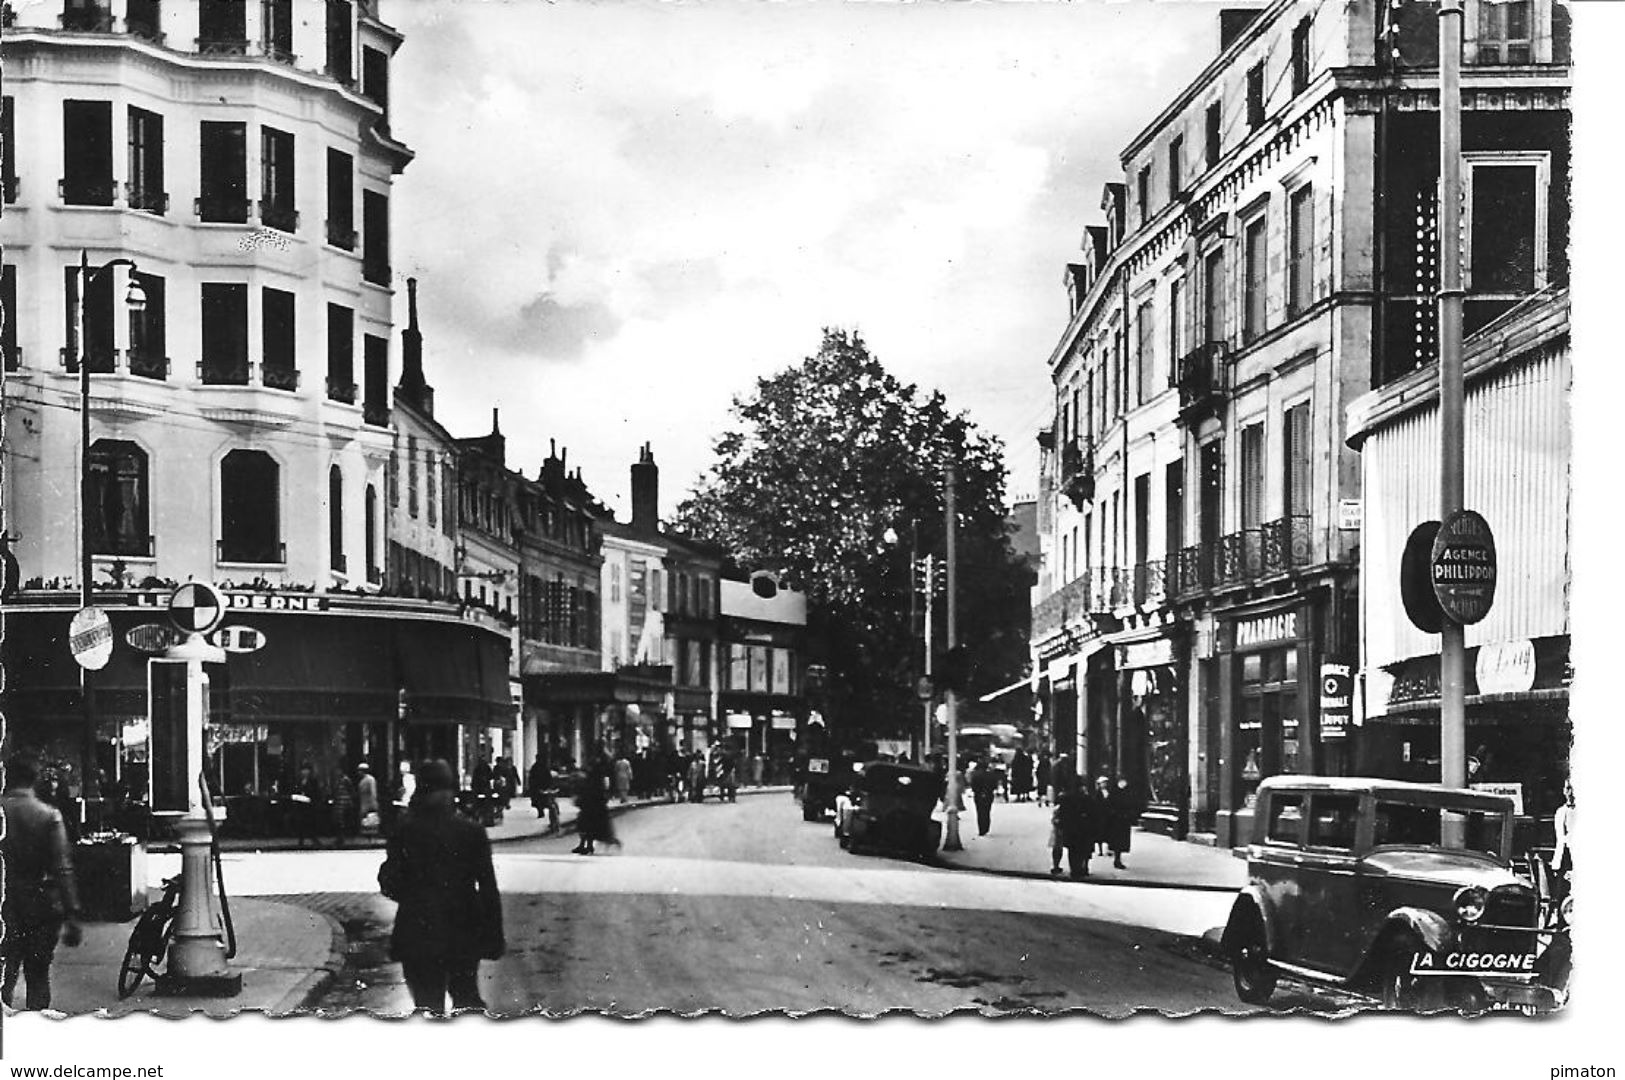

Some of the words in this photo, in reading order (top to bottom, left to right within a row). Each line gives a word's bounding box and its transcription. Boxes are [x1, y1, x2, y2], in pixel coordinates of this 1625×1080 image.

[1443, 548, 1488, 561] AGENCE
[1434, 564, 1495, 579] PHILIPPON
[138, 594, 171, 607] LE
[1236, 612, 1297, 646] PHARMACIE
